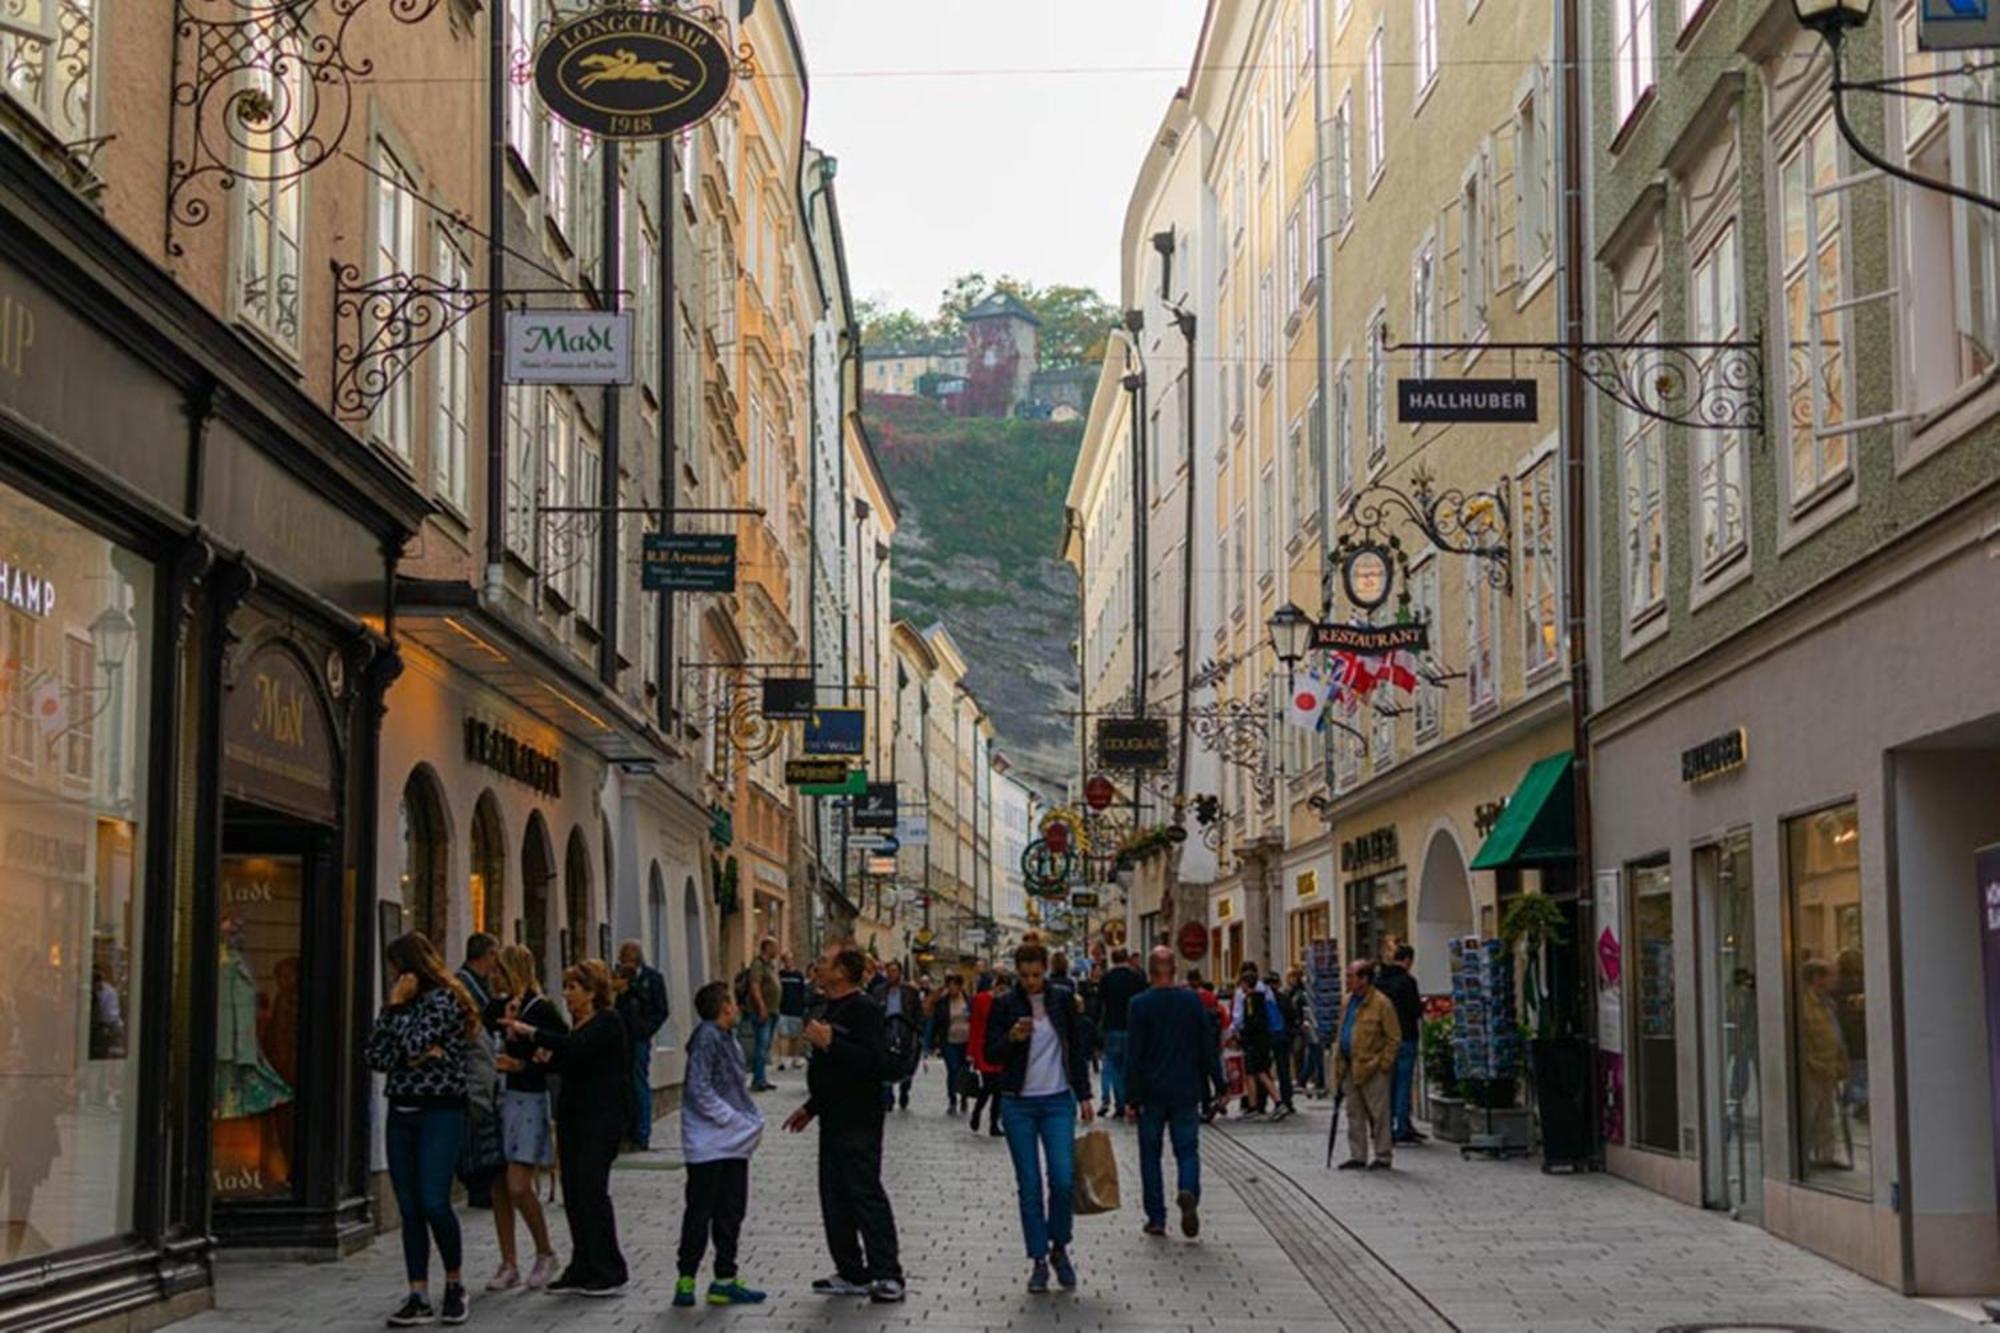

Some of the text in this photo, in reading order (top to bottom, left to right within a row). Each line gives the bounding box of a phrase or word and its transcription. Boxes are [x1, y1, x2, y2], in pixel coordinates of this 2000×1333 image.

[559, 14, 708, 50] LONGCHAMP
[609, 115, 653, 134] 1948
[523, 325, 614, 353] Madl
[1409, 393, 1526, 409] HALLHUBER
[1319, 629, 1418, 648] RESTAURANT
